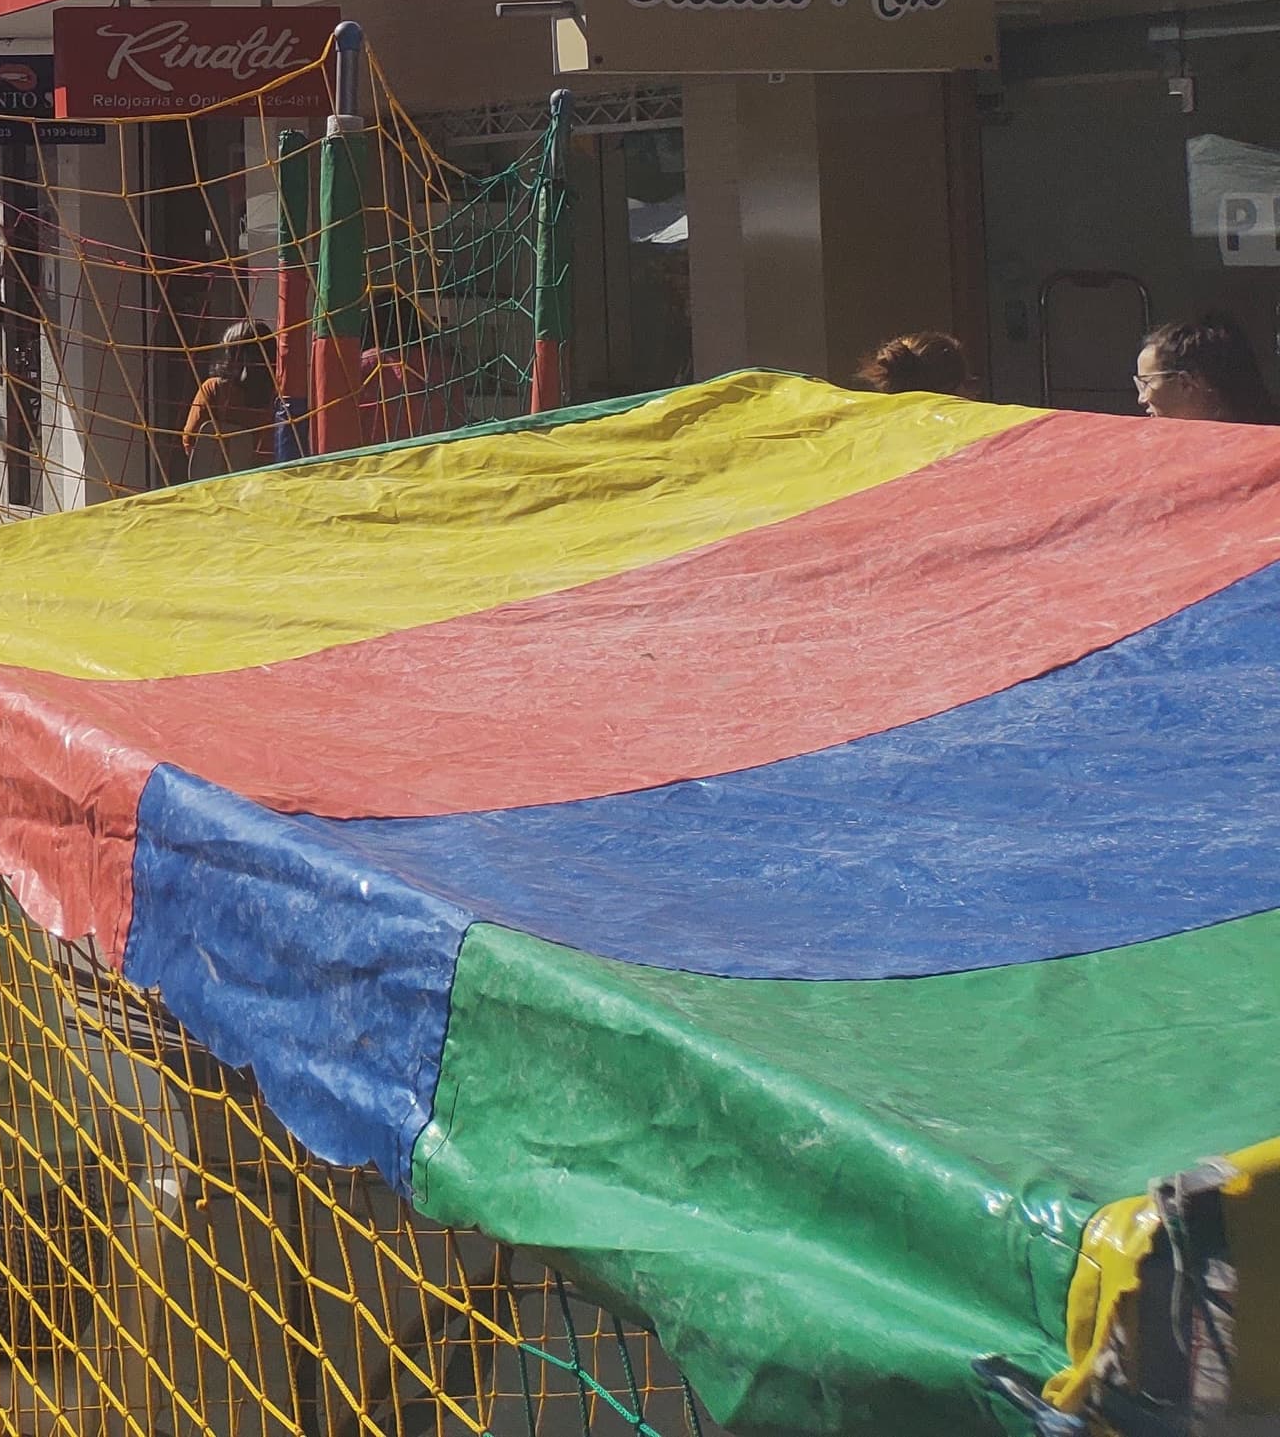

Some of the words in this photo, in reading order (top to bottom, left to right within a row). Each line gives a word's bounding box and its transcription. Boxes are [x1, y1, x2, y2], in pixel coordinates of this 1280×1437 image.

[96, 20, 313, 91] Rinaldi
[92, 93, 171, 110] Relojoaria
[175, 97, 184, 106] e
[248, 94, 320, 107] 326-4811
